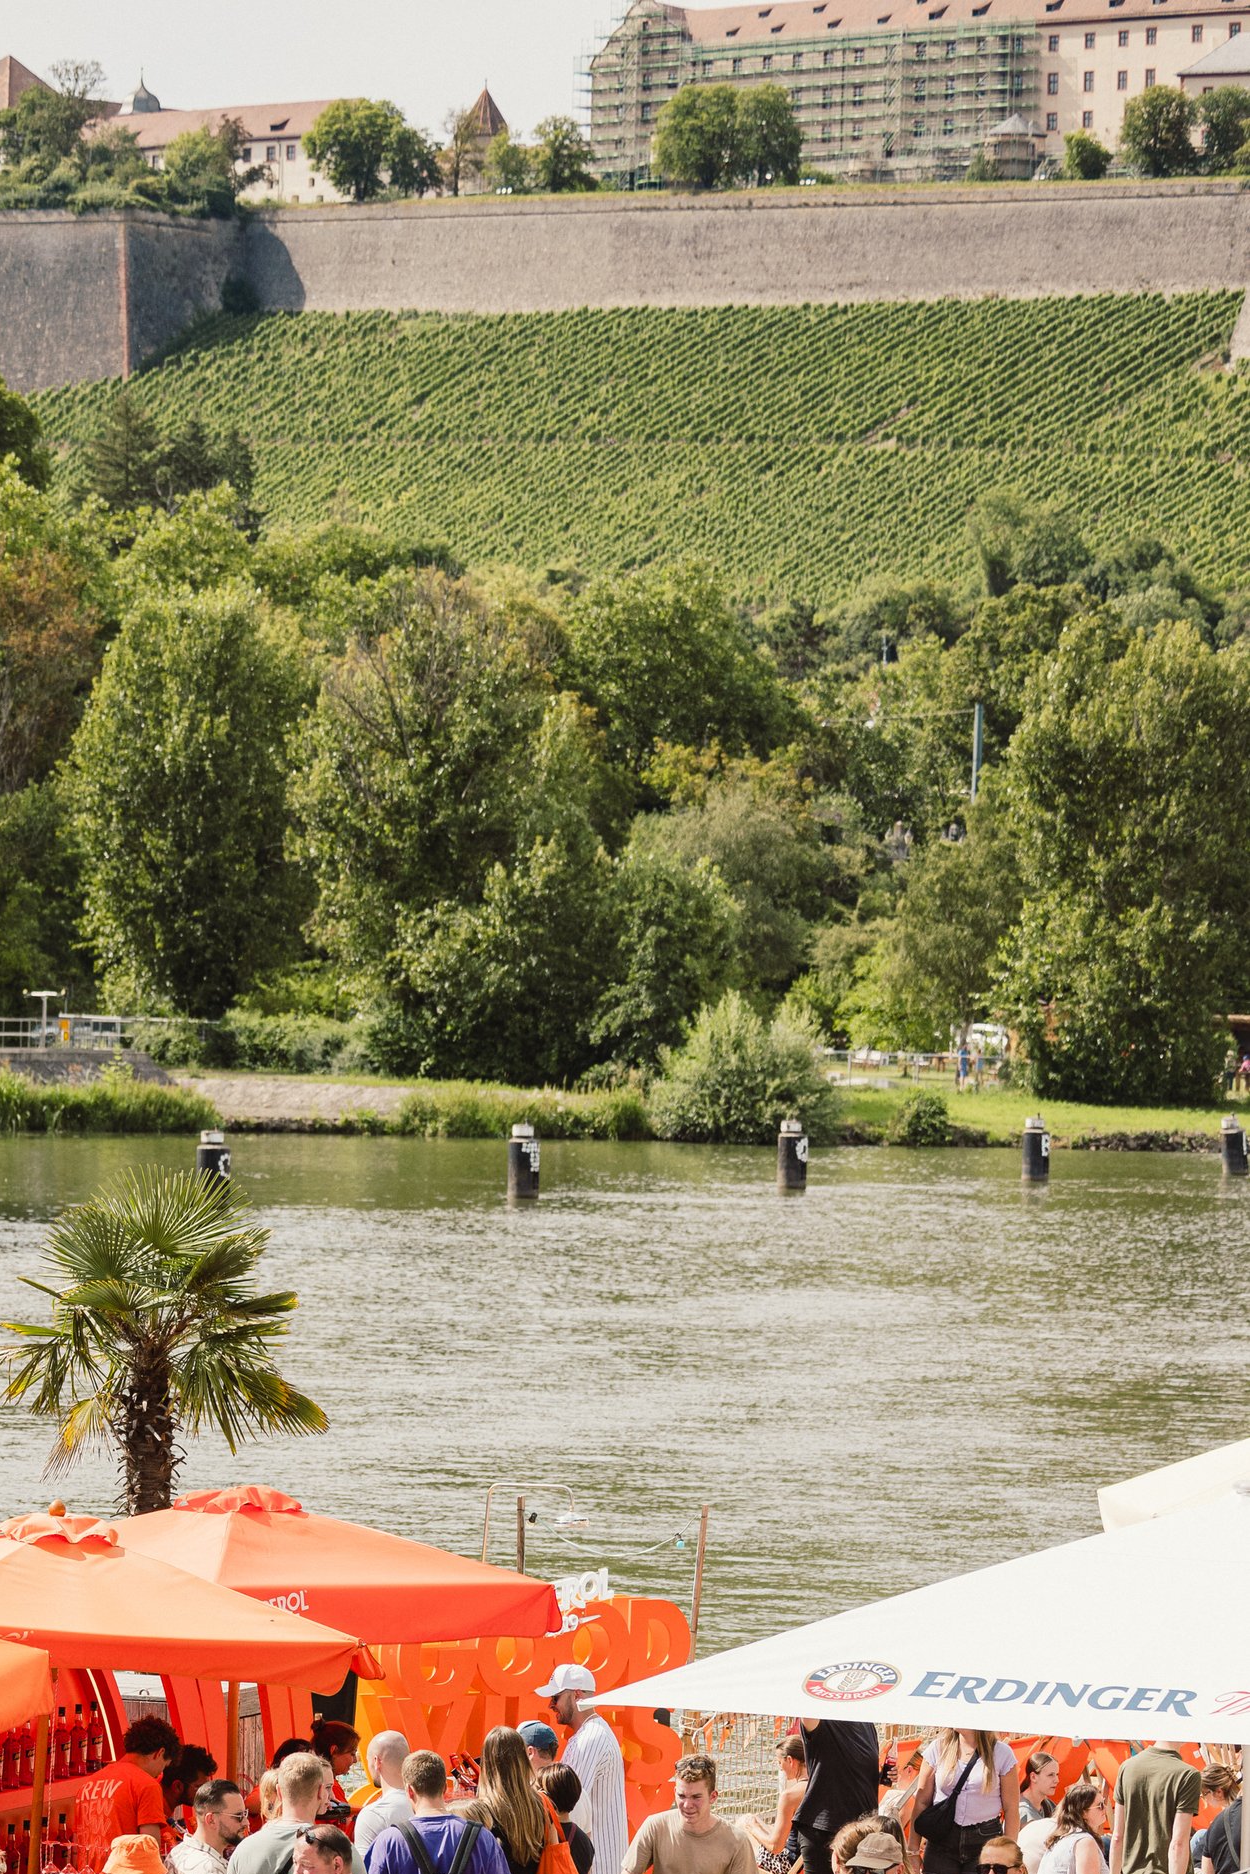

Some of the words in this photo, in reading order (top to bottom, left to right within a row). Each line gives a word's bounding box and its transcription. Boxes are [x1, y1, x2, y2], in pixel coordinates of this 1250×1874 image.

[554, 1567, 615, 1611] ROL
[815, 1662, 897, 1682] ERDINGER
[909, 1671, 1198, 1717] ERDINGER
[80, 1779, 124, 1802] REW
